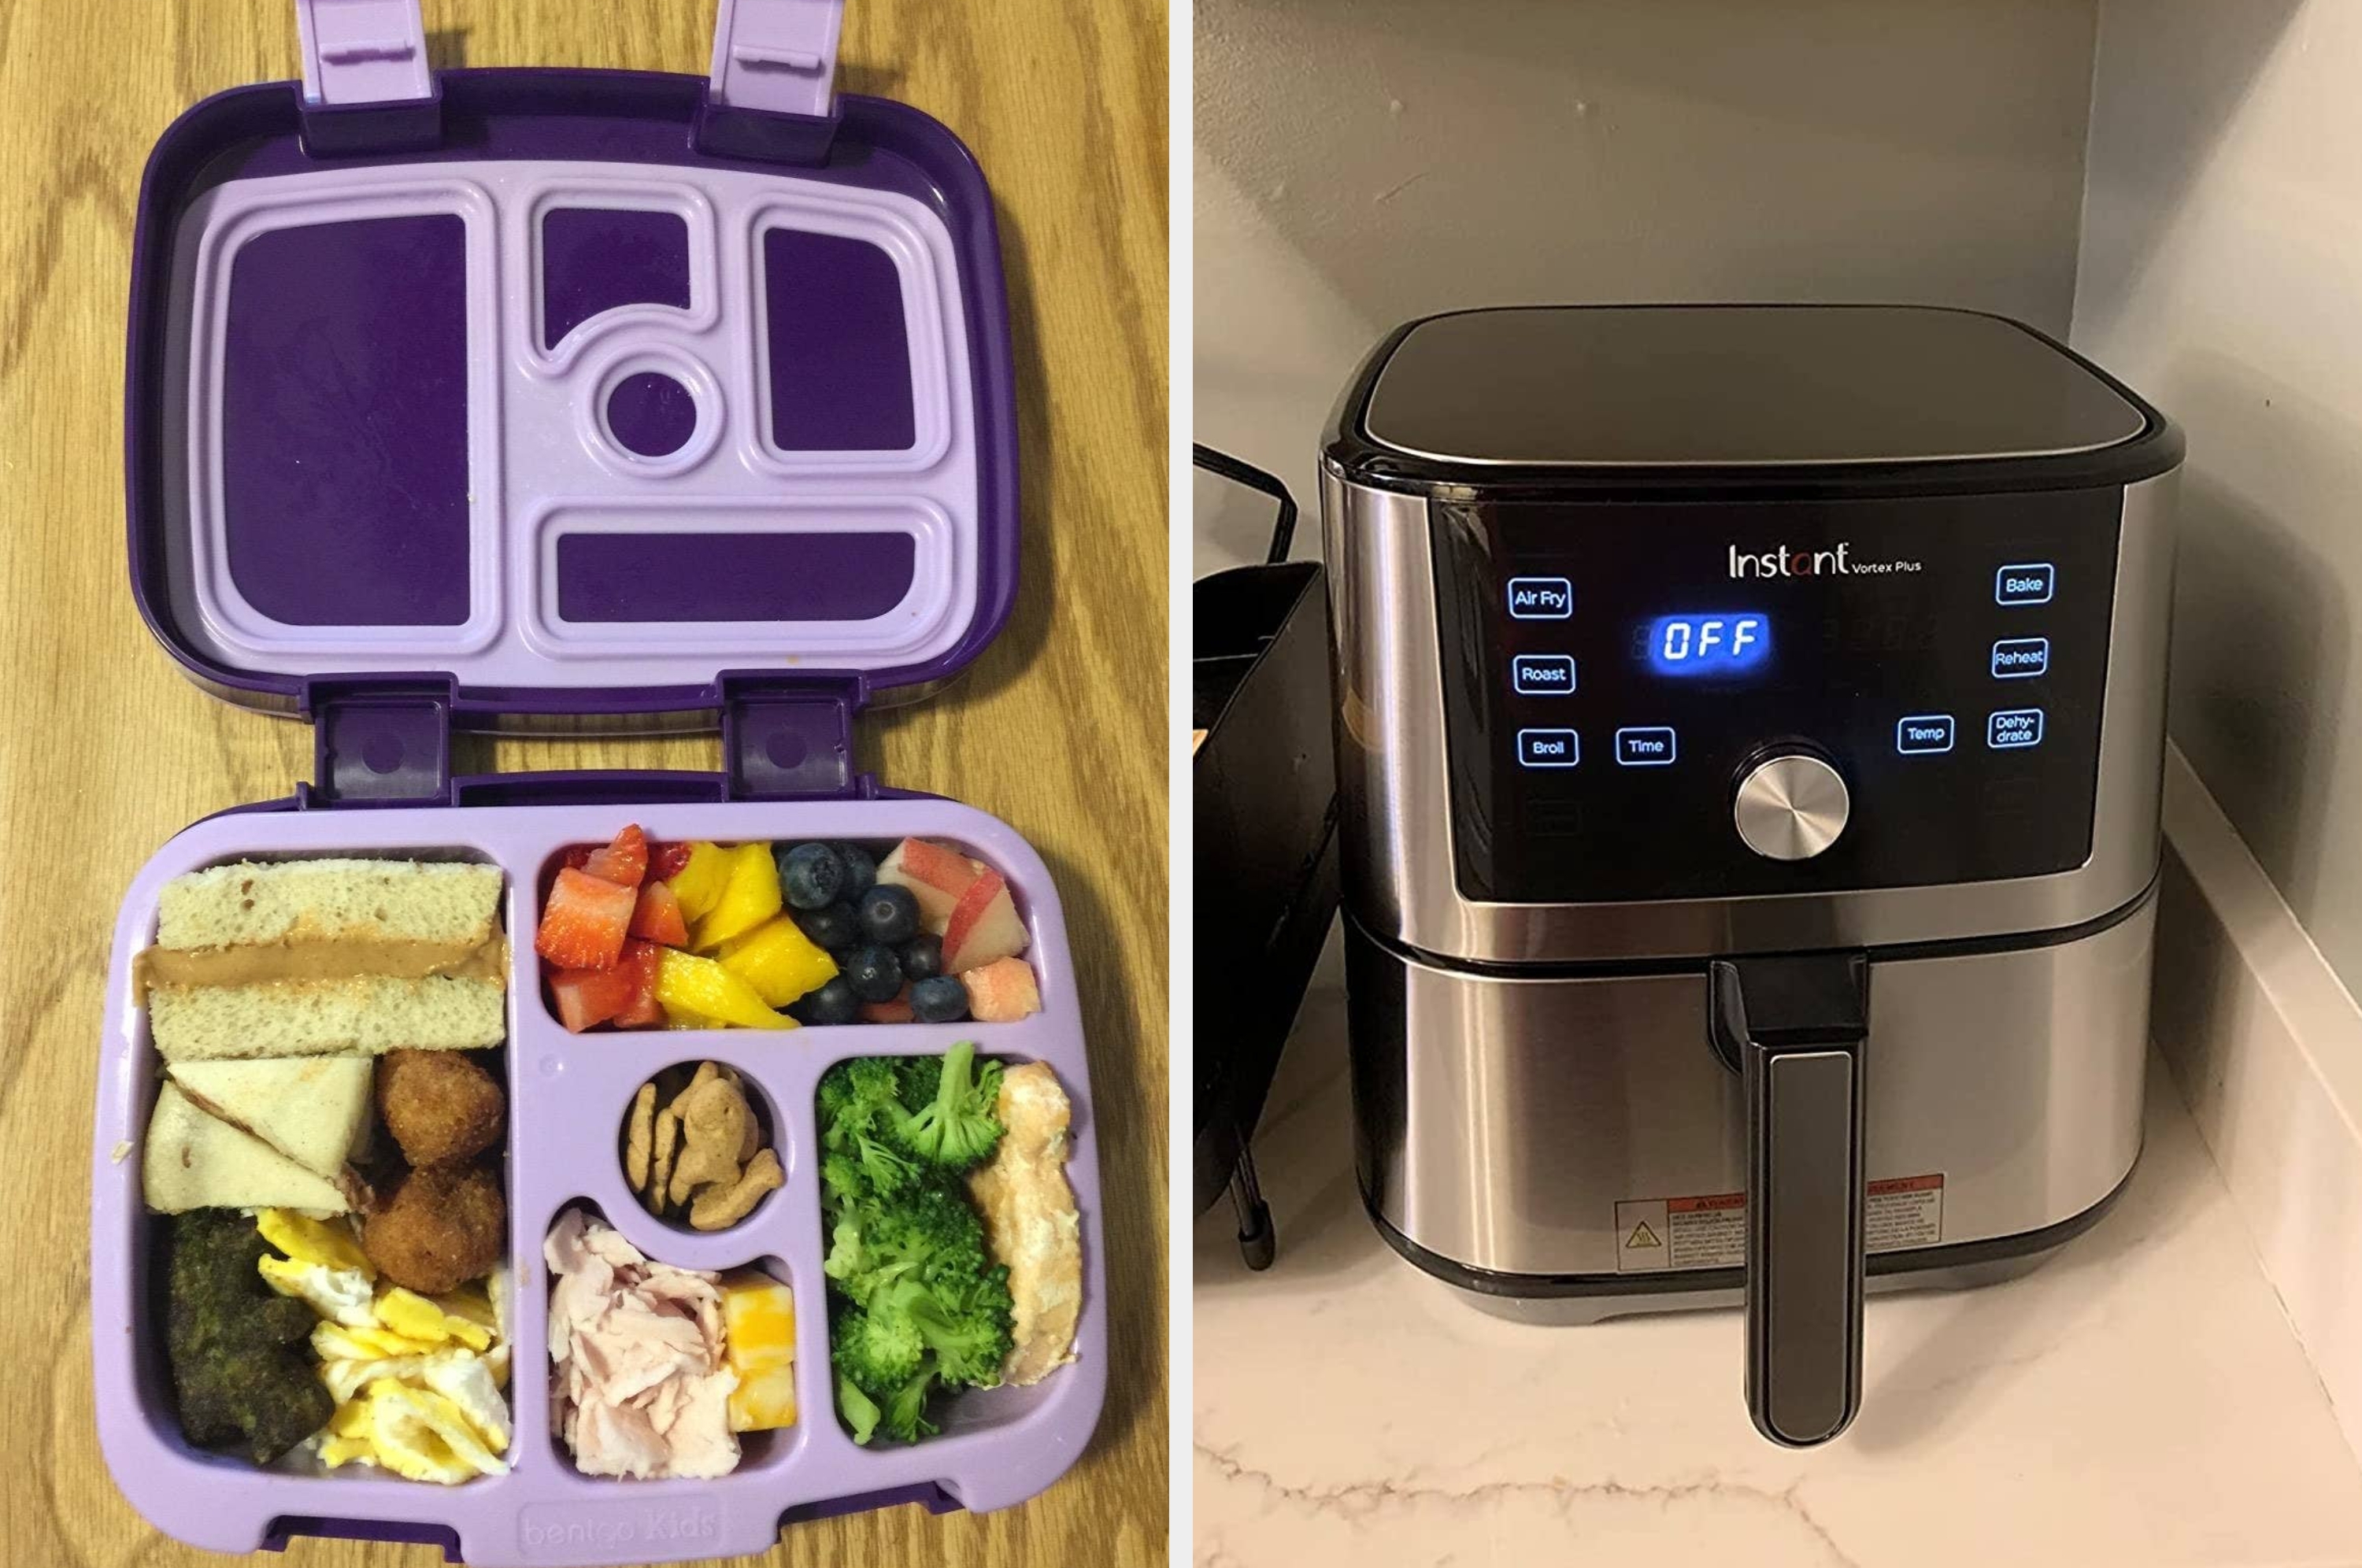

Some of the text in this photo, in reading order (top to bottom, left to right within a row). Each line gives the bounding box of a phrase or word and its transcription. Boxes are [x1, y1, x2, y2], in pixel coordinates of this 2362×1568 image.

[1729, 542, 1921, 578] Instant Vortex Plus
[2006, 578, 2043, 592] Bake
[1515, 591, 1566, 608] Air Fry
[1664, 620, 1758, 660] OFF
[1995, 651, 2043, 665] Reheat
[1522, 668, 1567, 680] Roast
[1996, 716, 2034, 729] Dehy-
[1907, 727, 1945, 741] Temp
[1997, 730, 2032, 742] drate
[1533, 741, 1564, 753] Broil
[1628, 740, 1664, 753] Time
